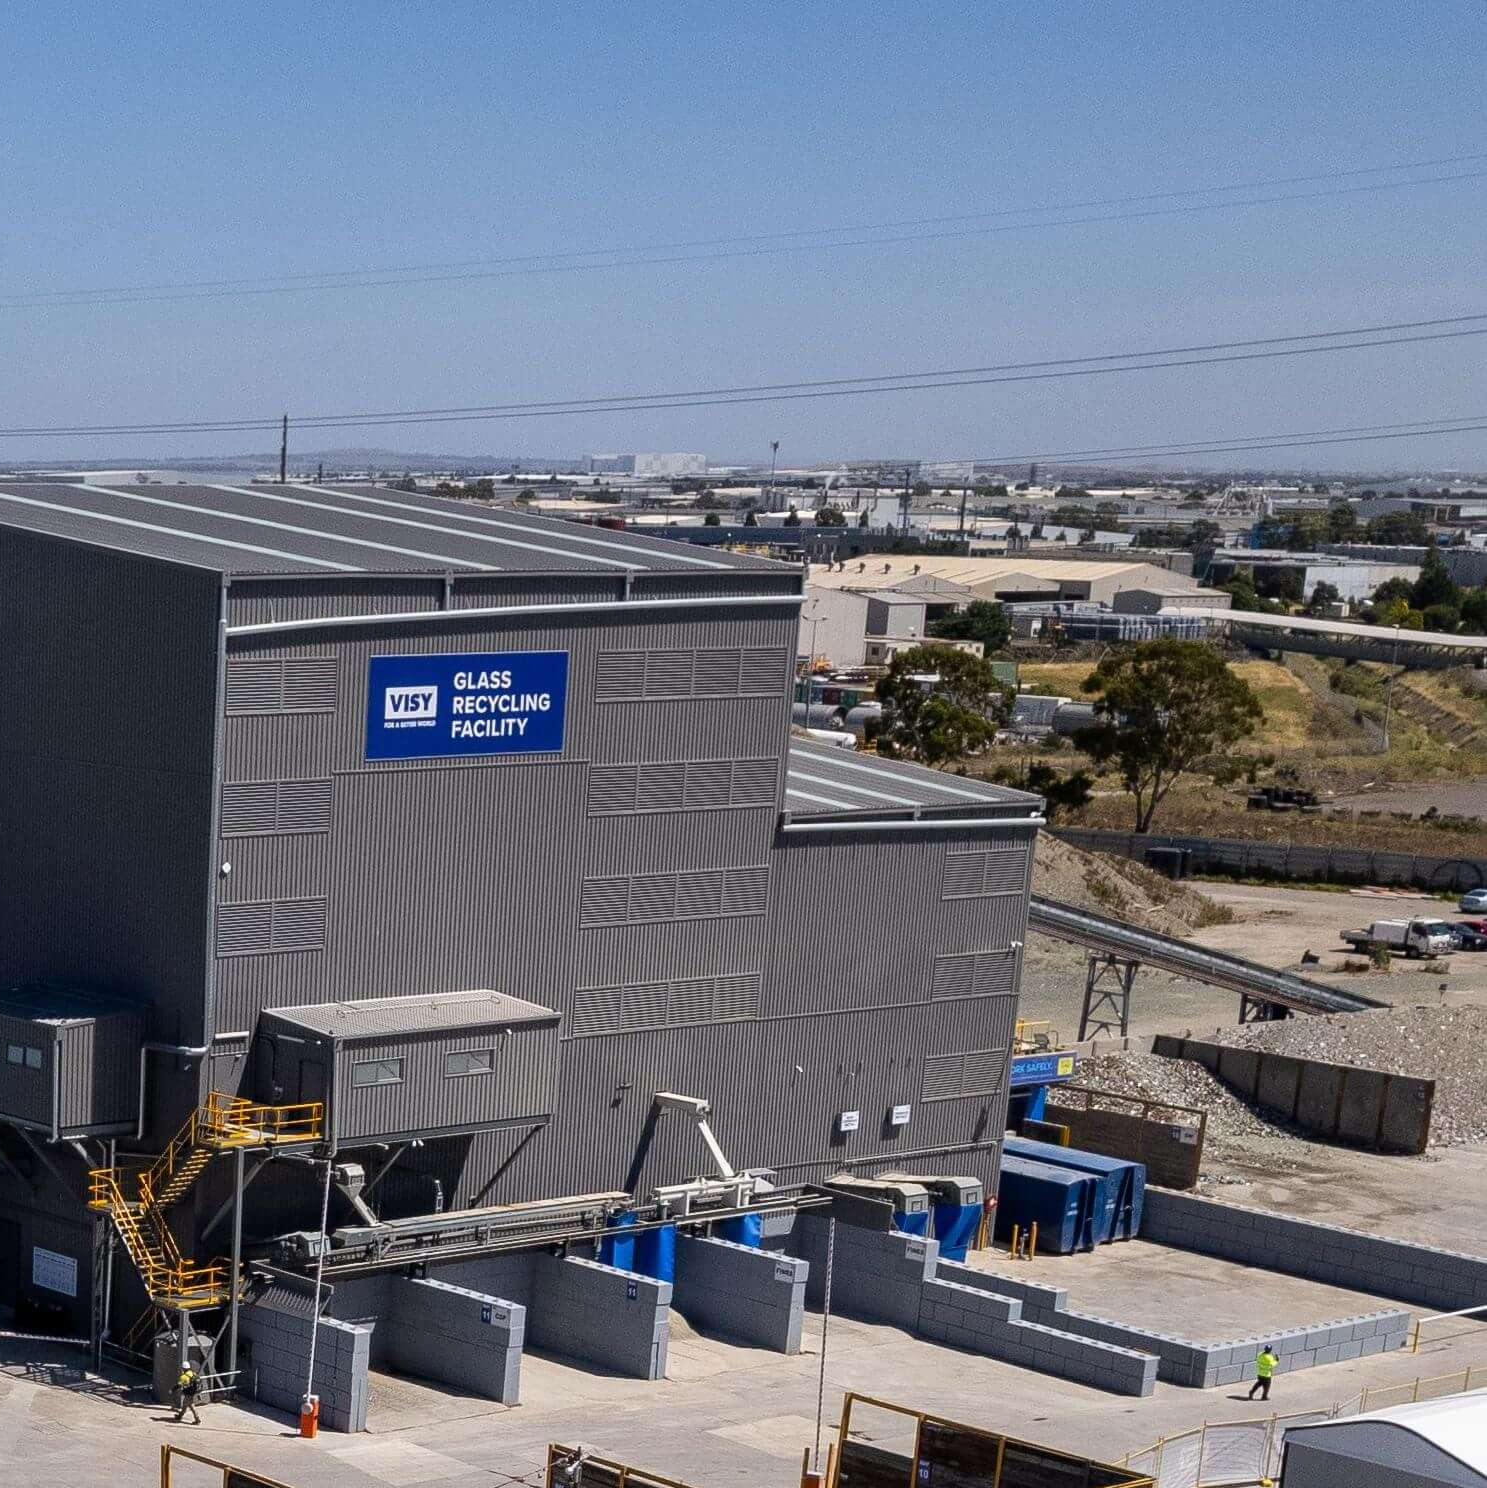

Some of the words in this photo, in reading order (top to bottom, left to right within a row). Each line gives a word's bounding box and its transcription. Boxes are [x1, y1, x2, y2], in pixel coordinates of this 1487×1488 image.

[454, 671, 512, 690] GLASS
[390, 693, 432, 713] VISY
[453, 693, 550, 714] RECYCLING
[451, 718, 528, 738] FACILITY
